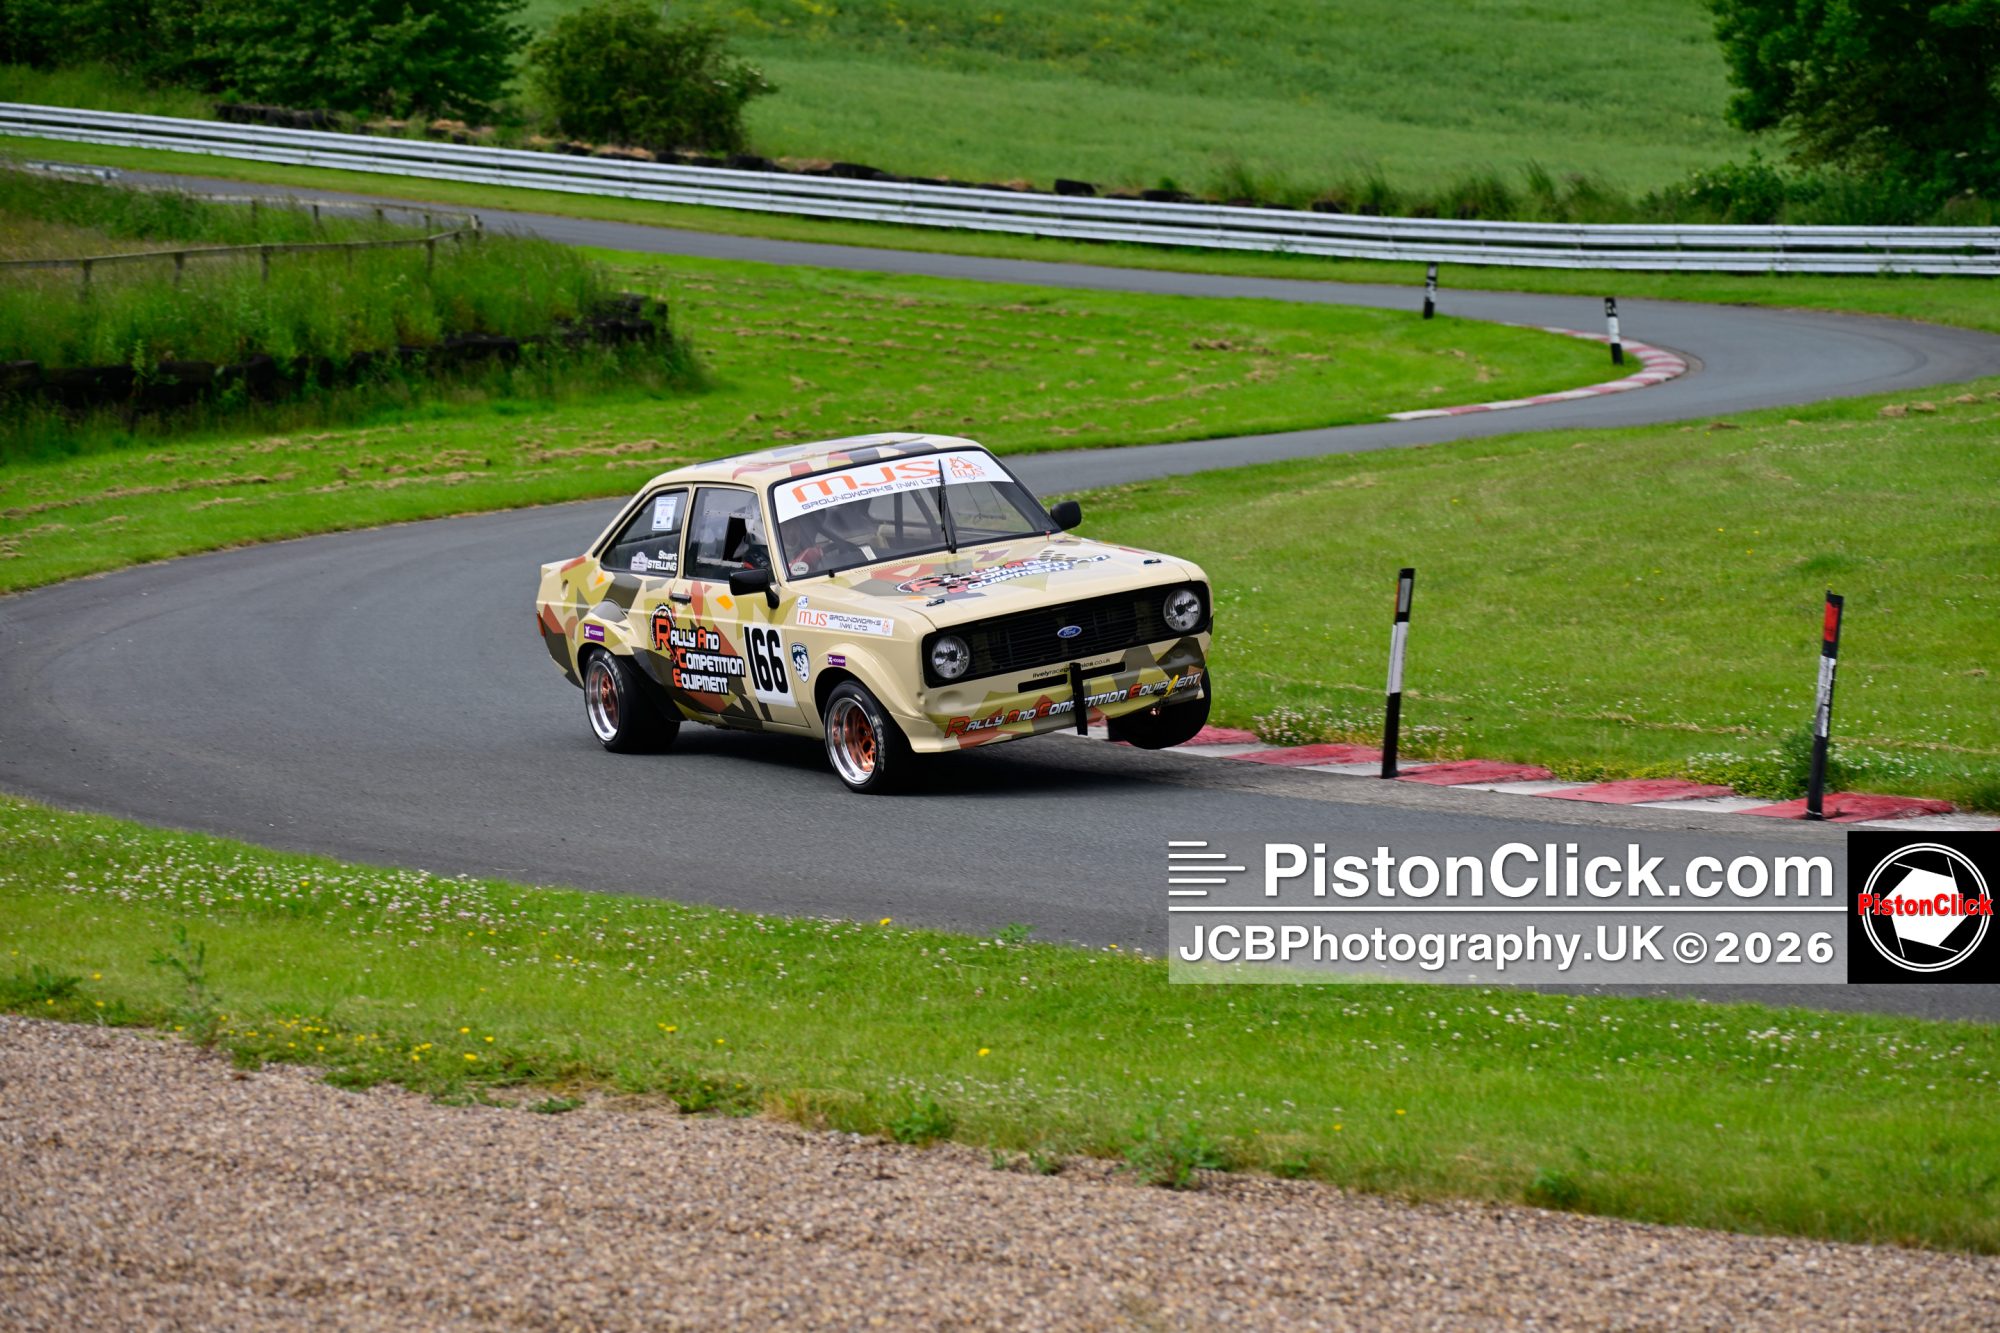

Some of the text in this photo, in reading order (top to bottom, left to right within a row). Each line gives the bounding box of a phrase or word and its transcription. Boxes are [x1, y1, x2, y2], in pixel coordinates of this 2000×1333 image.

[792, 460, 940, 503] MJS
[801, 484, 893, 510] GROUNDWORKS
[658, 550, 677, 560] Stuart
[648, 560, 677, 571] STELLING
[799, 611, 828, 626] MJS
[829, 614, 881, 626] GROUNDWORKS
[744, 626, 788, 694] 166
[1036, 690, 1126, 718] COMPTITION
